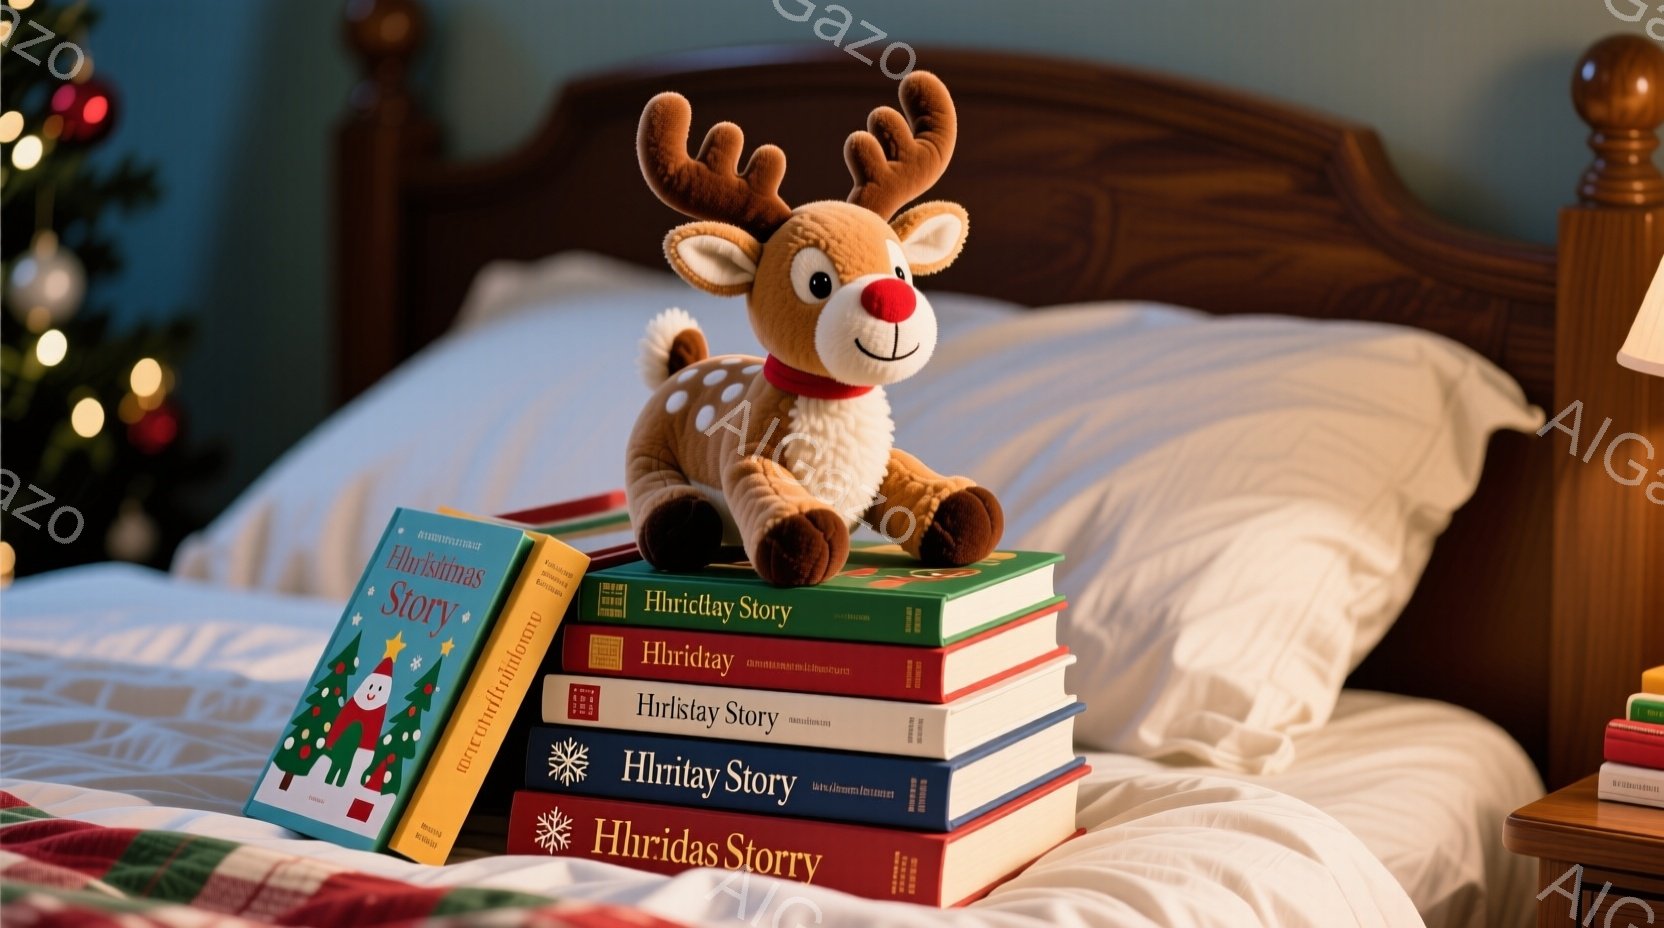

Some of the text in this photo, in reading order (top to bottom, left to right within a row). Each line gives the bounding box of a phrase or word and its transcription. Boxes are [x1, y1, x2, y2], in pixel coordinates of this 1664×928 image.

[380, 580, 460, 639] Story
[739, 595, 793, 629] Story
[725, 700, 780, 736] Story
[725, 759, 798, 806] Story
[724, 832, 823, 886] Storry
